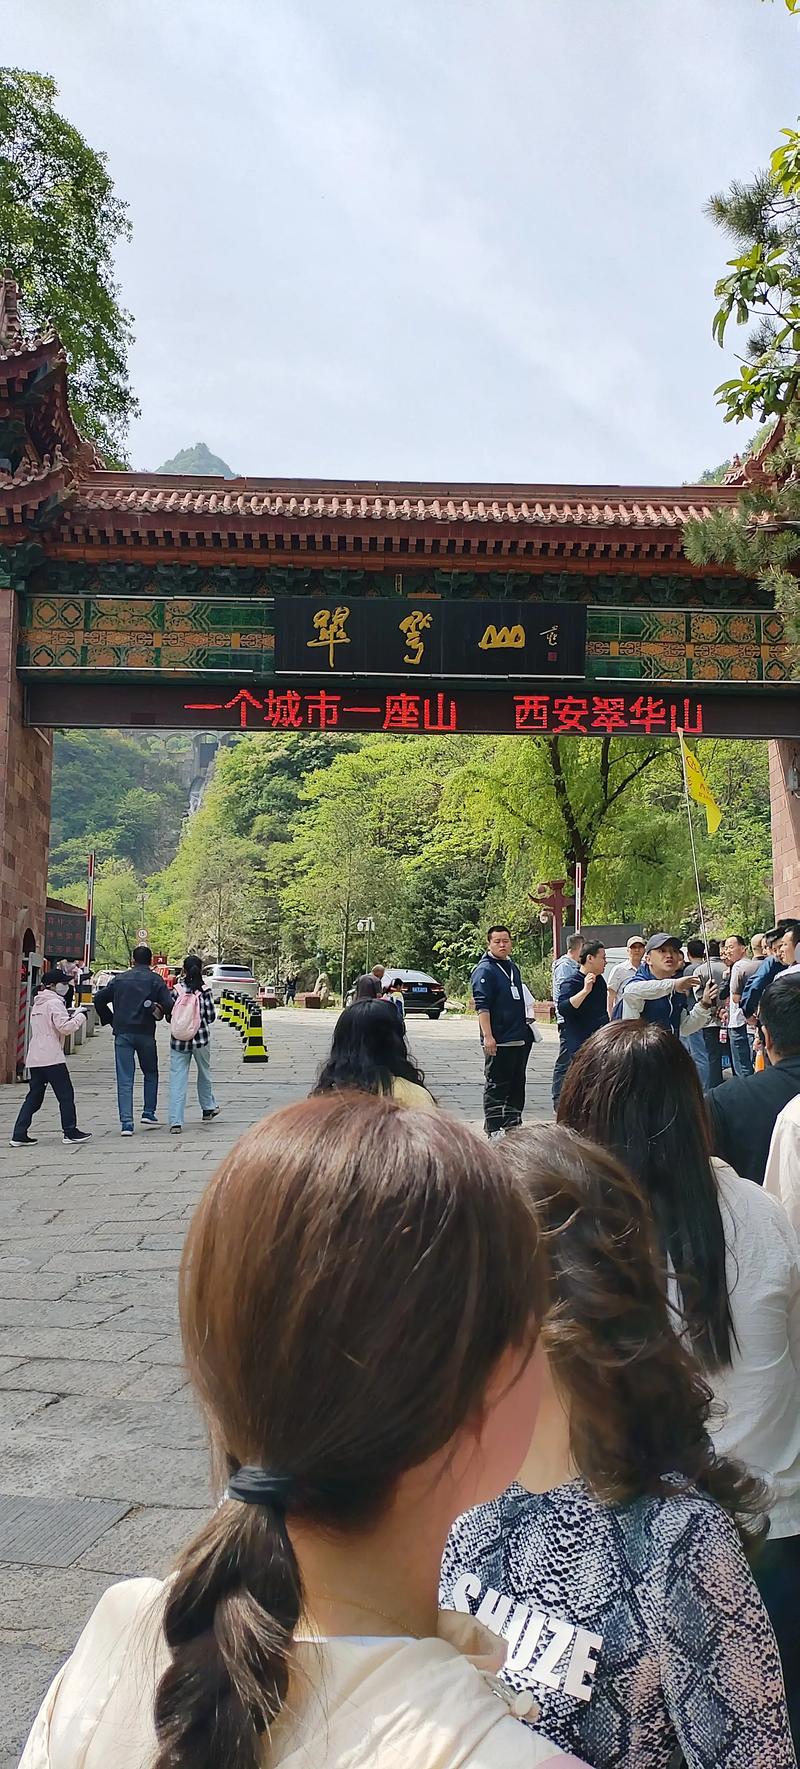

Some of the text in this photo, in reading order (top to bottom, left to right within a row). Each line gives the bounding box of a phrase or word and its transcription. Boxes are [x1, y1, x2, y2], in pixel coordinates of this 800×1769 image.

[183, 689, 703, 734] 一个城市一座山 西安翠华山
